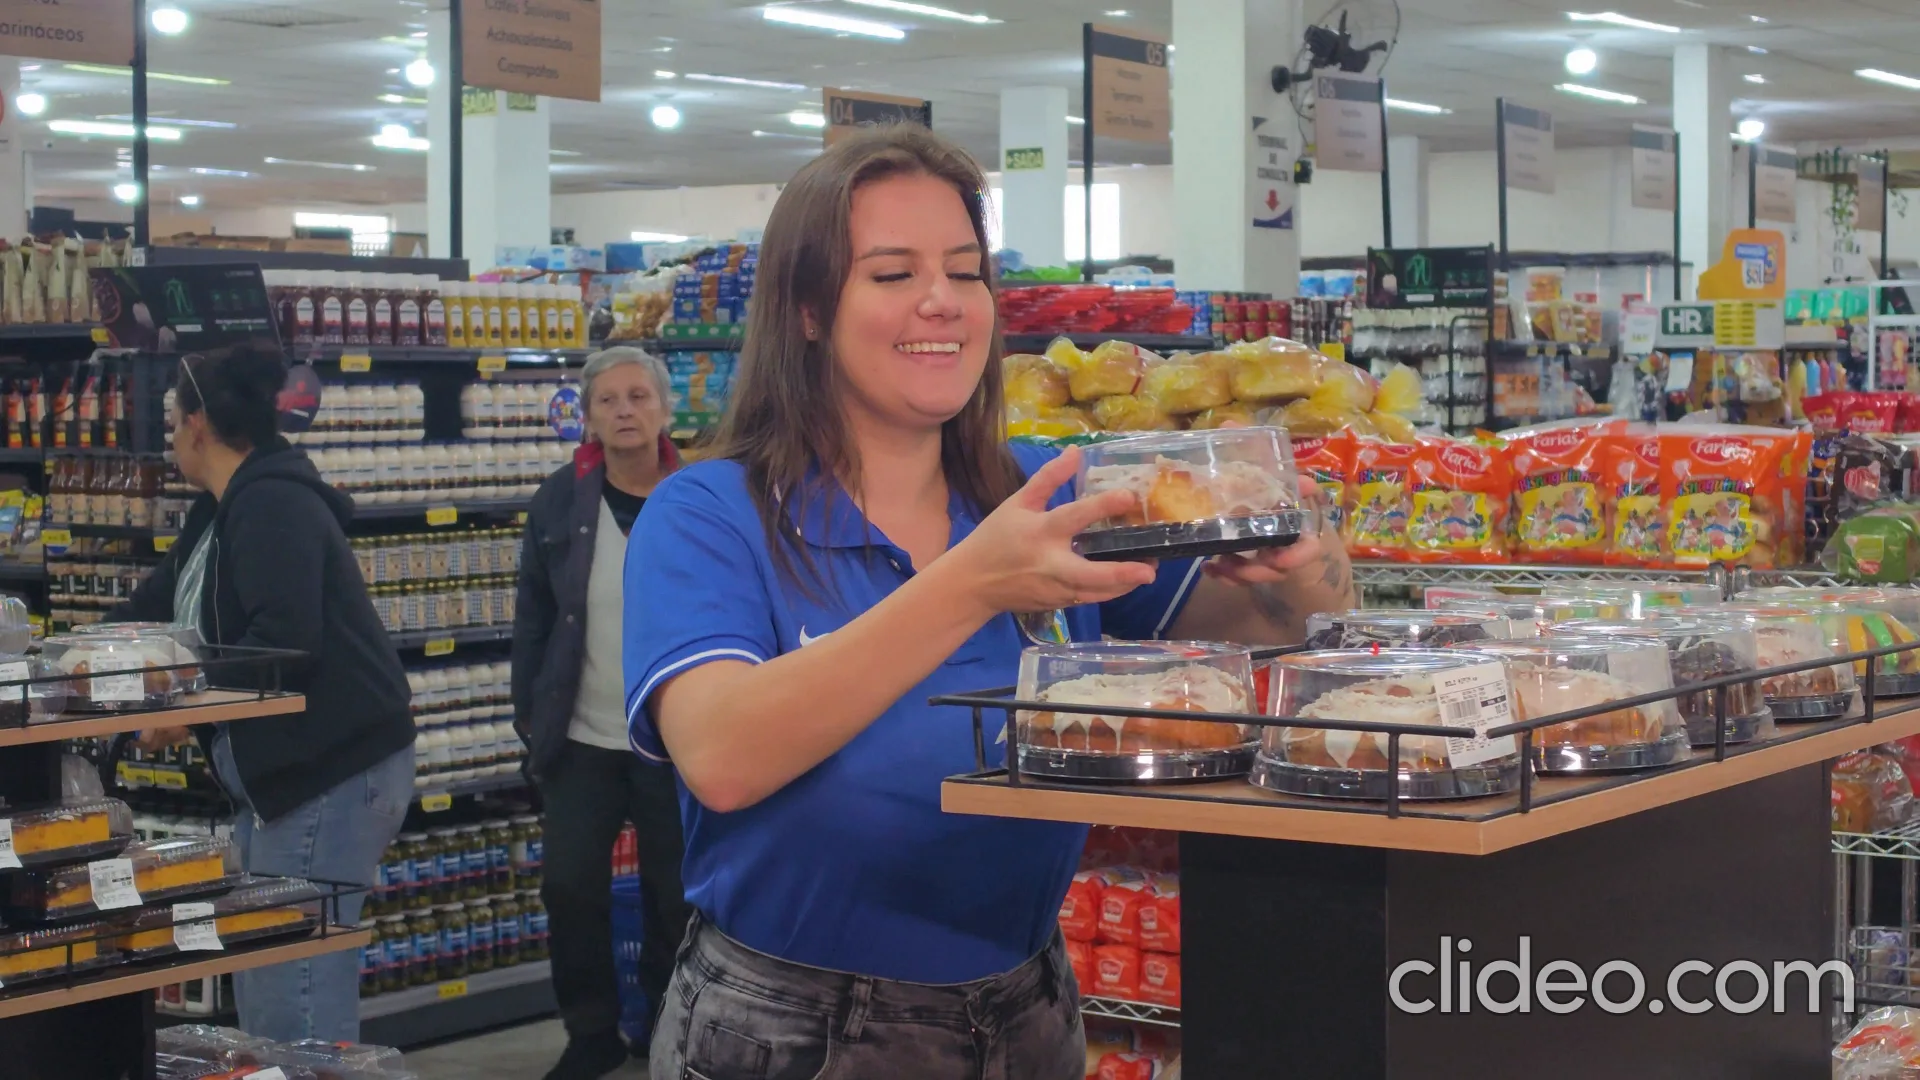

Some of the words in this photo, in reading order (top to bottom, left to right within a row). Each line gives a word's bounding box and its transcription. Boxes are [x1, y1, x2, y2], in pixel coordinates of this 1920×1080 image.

[1146, 42, 1164, 66] 05
[832, 98, 855, 125] 04
[1668, 308, 1703, 334] HR
[1533, 433, 1580, 448] Farias
